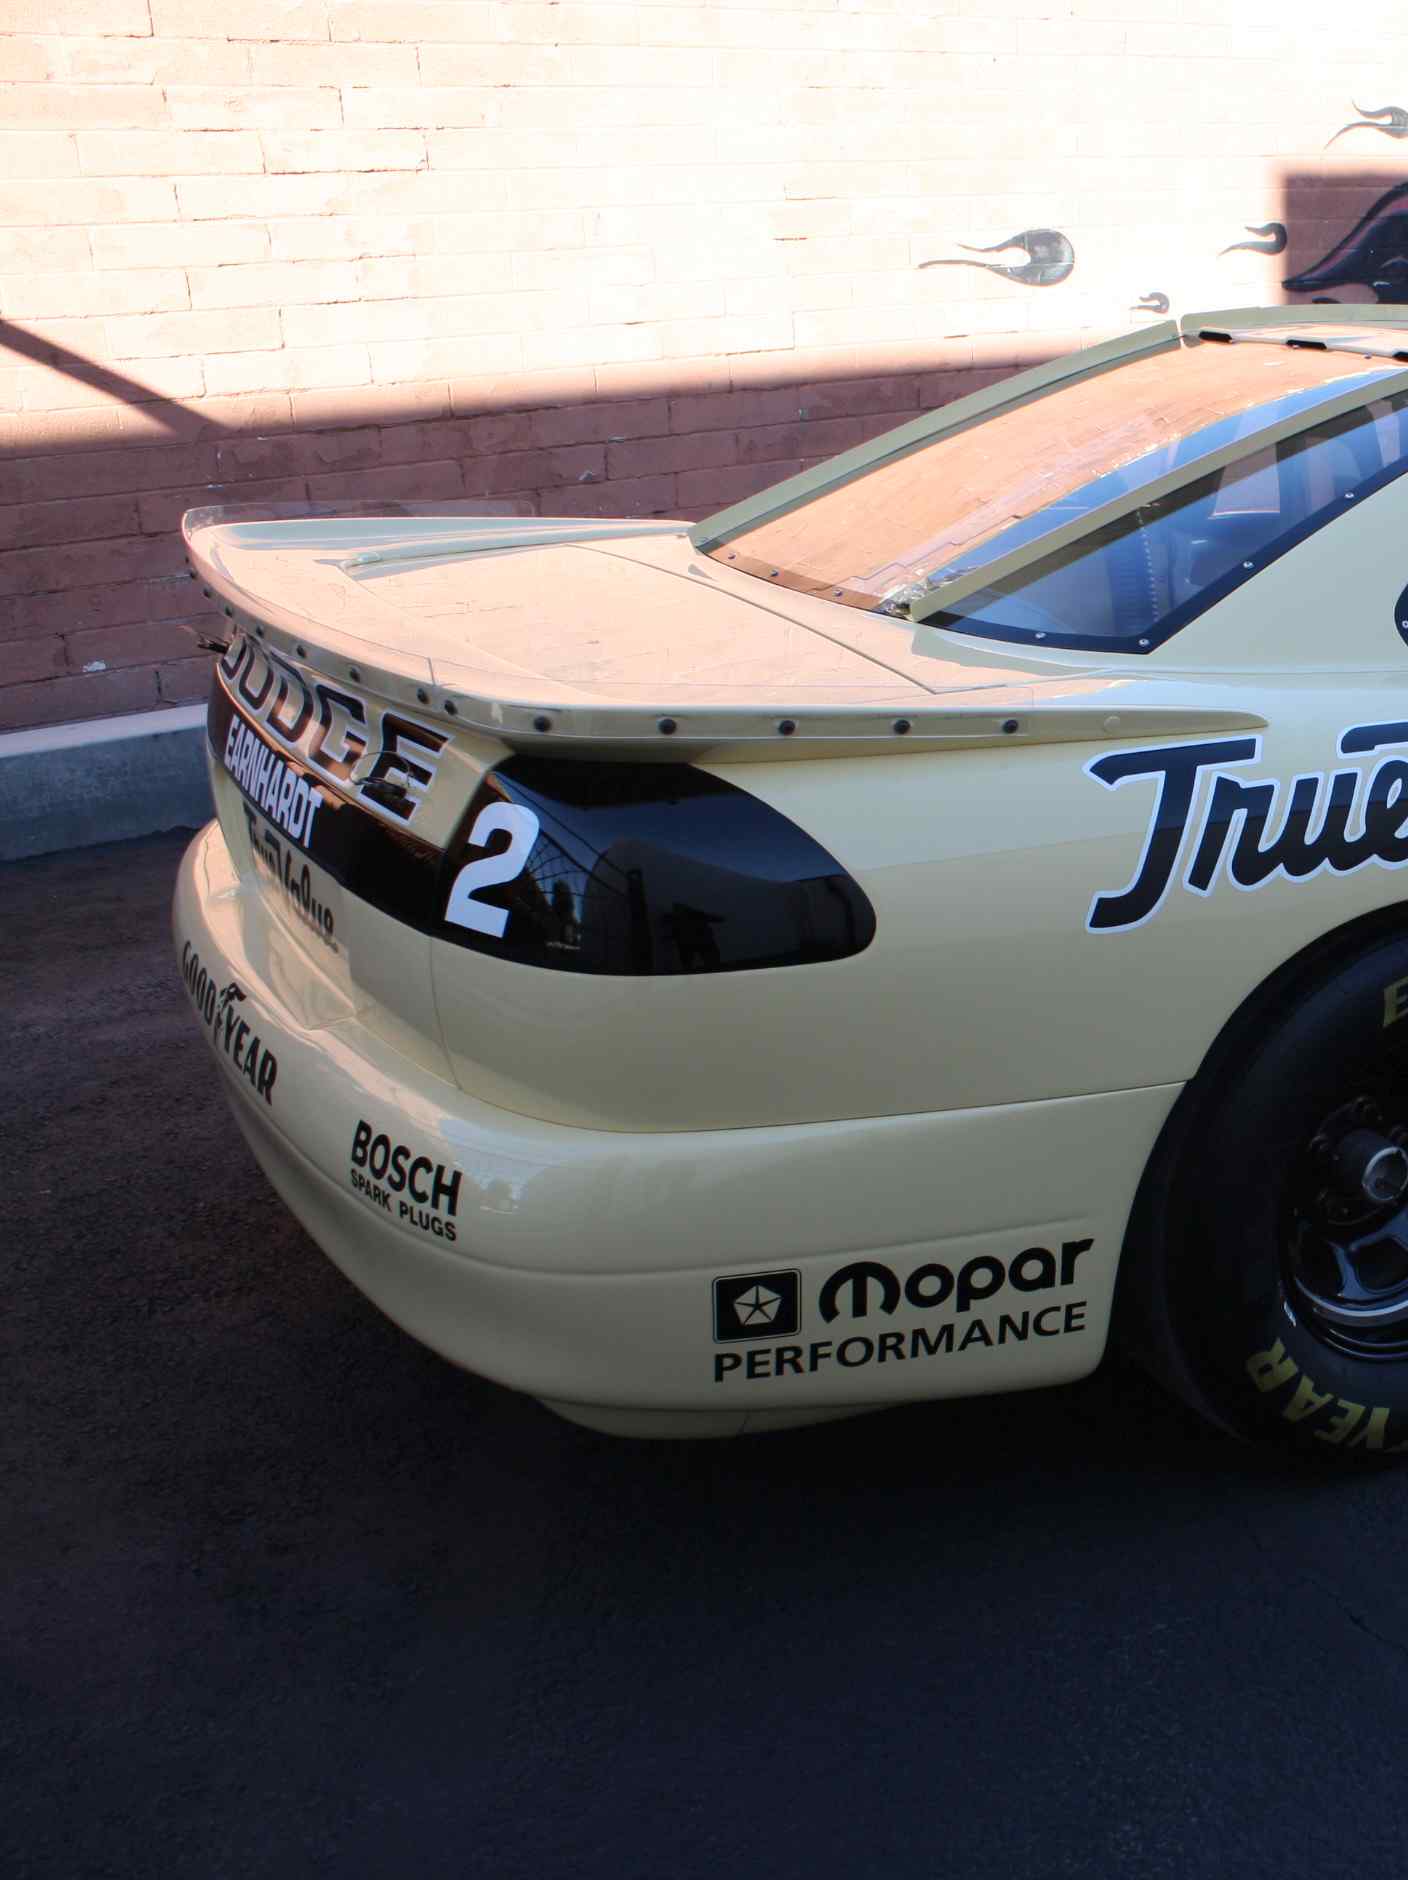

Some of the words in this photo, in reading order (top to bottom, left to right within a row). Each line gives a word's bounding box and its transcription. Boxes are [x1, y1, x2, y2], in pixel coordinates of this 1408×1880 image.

[223, 714, 325, 850] EARNHARDT
[445, 801, 540, 939] 2
[182, 940, 279, 1106] GOODYEAR
[350, 1168, 393, 1213] SPARK
[399, 1203, 458, 1243] PLUGS
[351, 1119, 463, 1217] BOSCH
[714, 1301, 1088, 1383] PERFORMANCE
